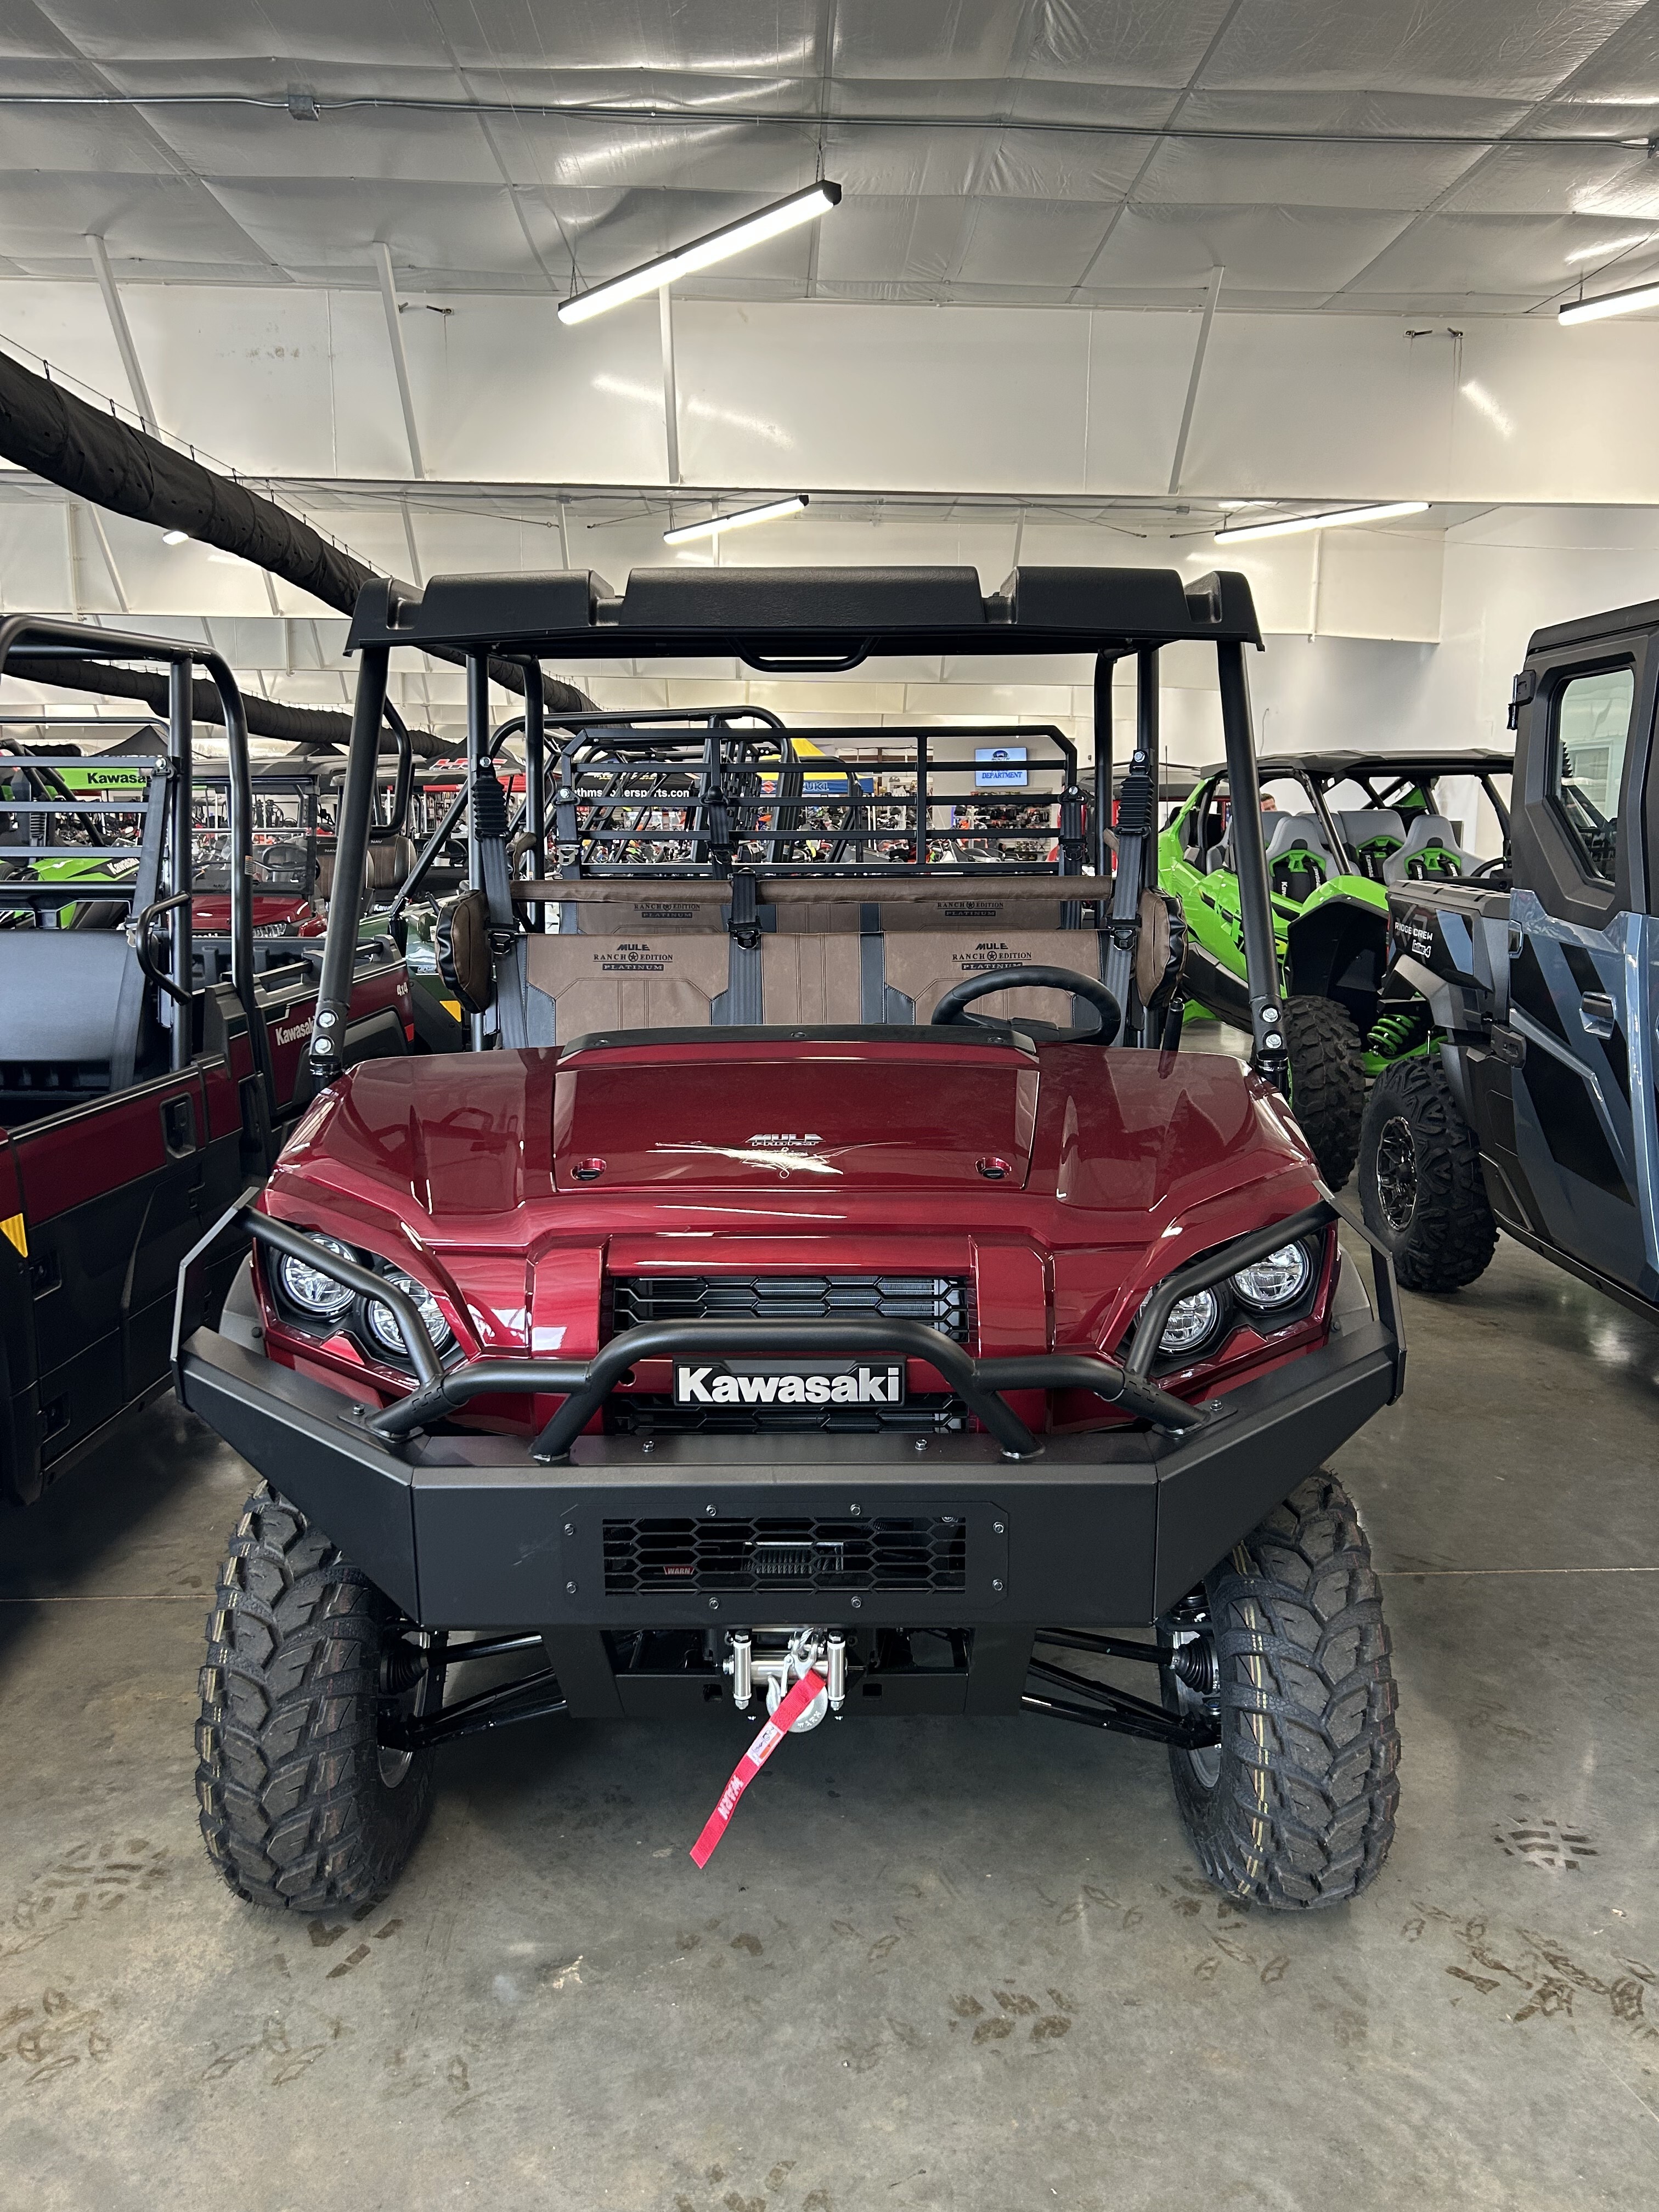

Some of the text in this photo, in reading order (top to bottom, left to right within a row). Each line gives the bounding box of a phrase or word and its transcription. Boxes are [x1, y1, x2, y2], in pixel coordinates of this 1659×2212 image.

[1395, 922, 1433, 941] RIDGE CREW
[745, 1133, 826, 1143] MULE
[678, 1367, 899, 1403] Kawasaki
[717, 1774, 744, 1820] WARN
